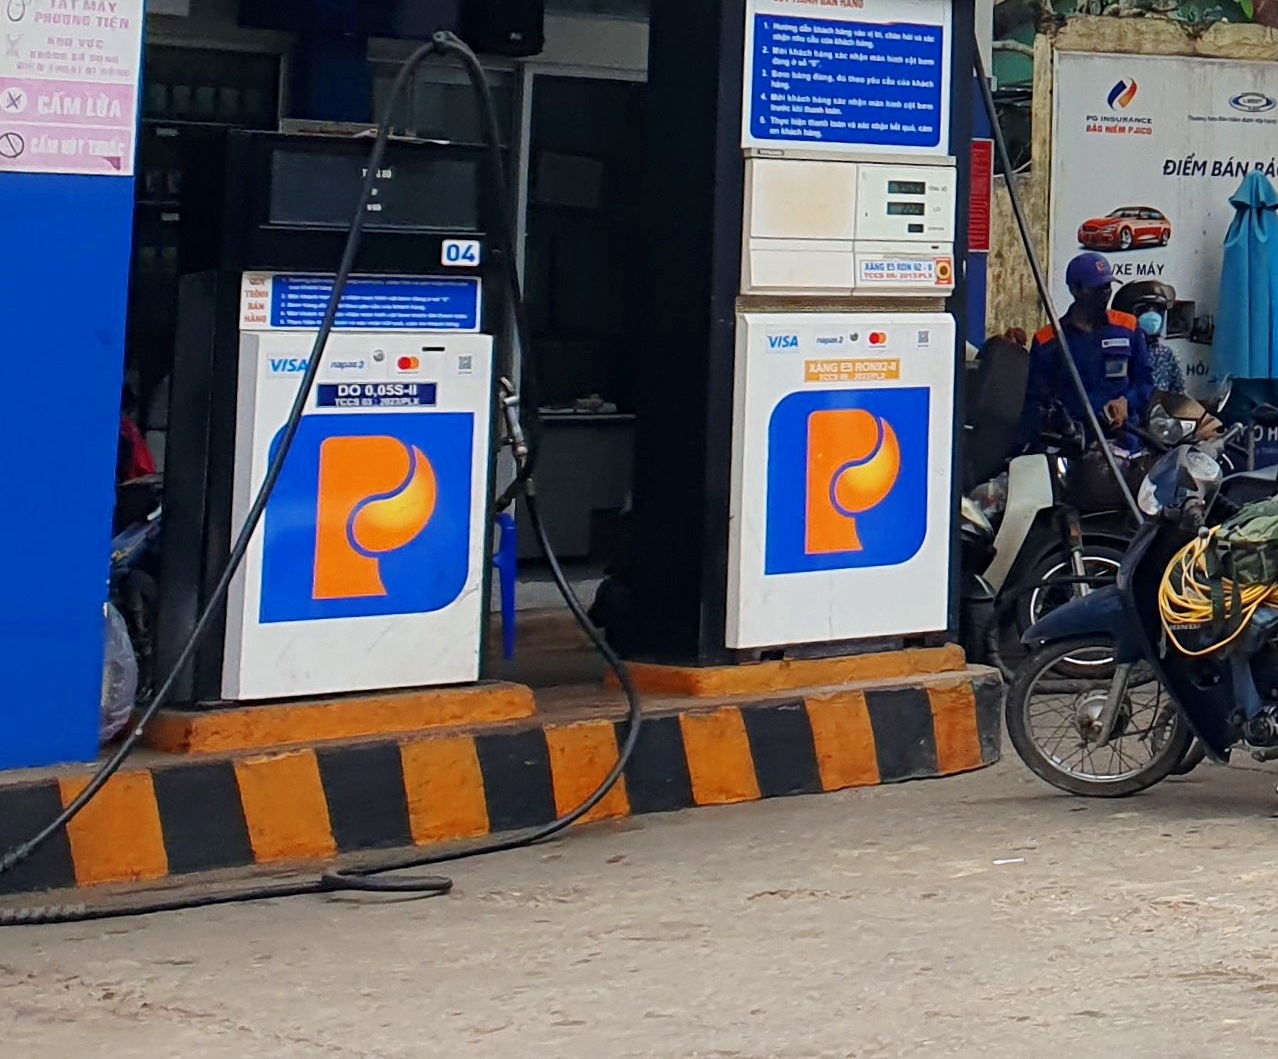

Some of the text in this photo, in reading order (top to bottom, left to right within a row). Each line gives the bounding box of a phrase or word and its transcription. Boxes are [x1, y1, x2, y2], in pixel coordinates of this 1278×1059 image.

[1162, 153, 1208, 177] ĐIỂM
[1211, 156, 1249, 178] BÁN
[446, 243, 476, 263] 04
[1136, 262, 1165, 277] MÁY
[767, 334, 799, 349] VISA
[338, 385, 361, 396] DO
